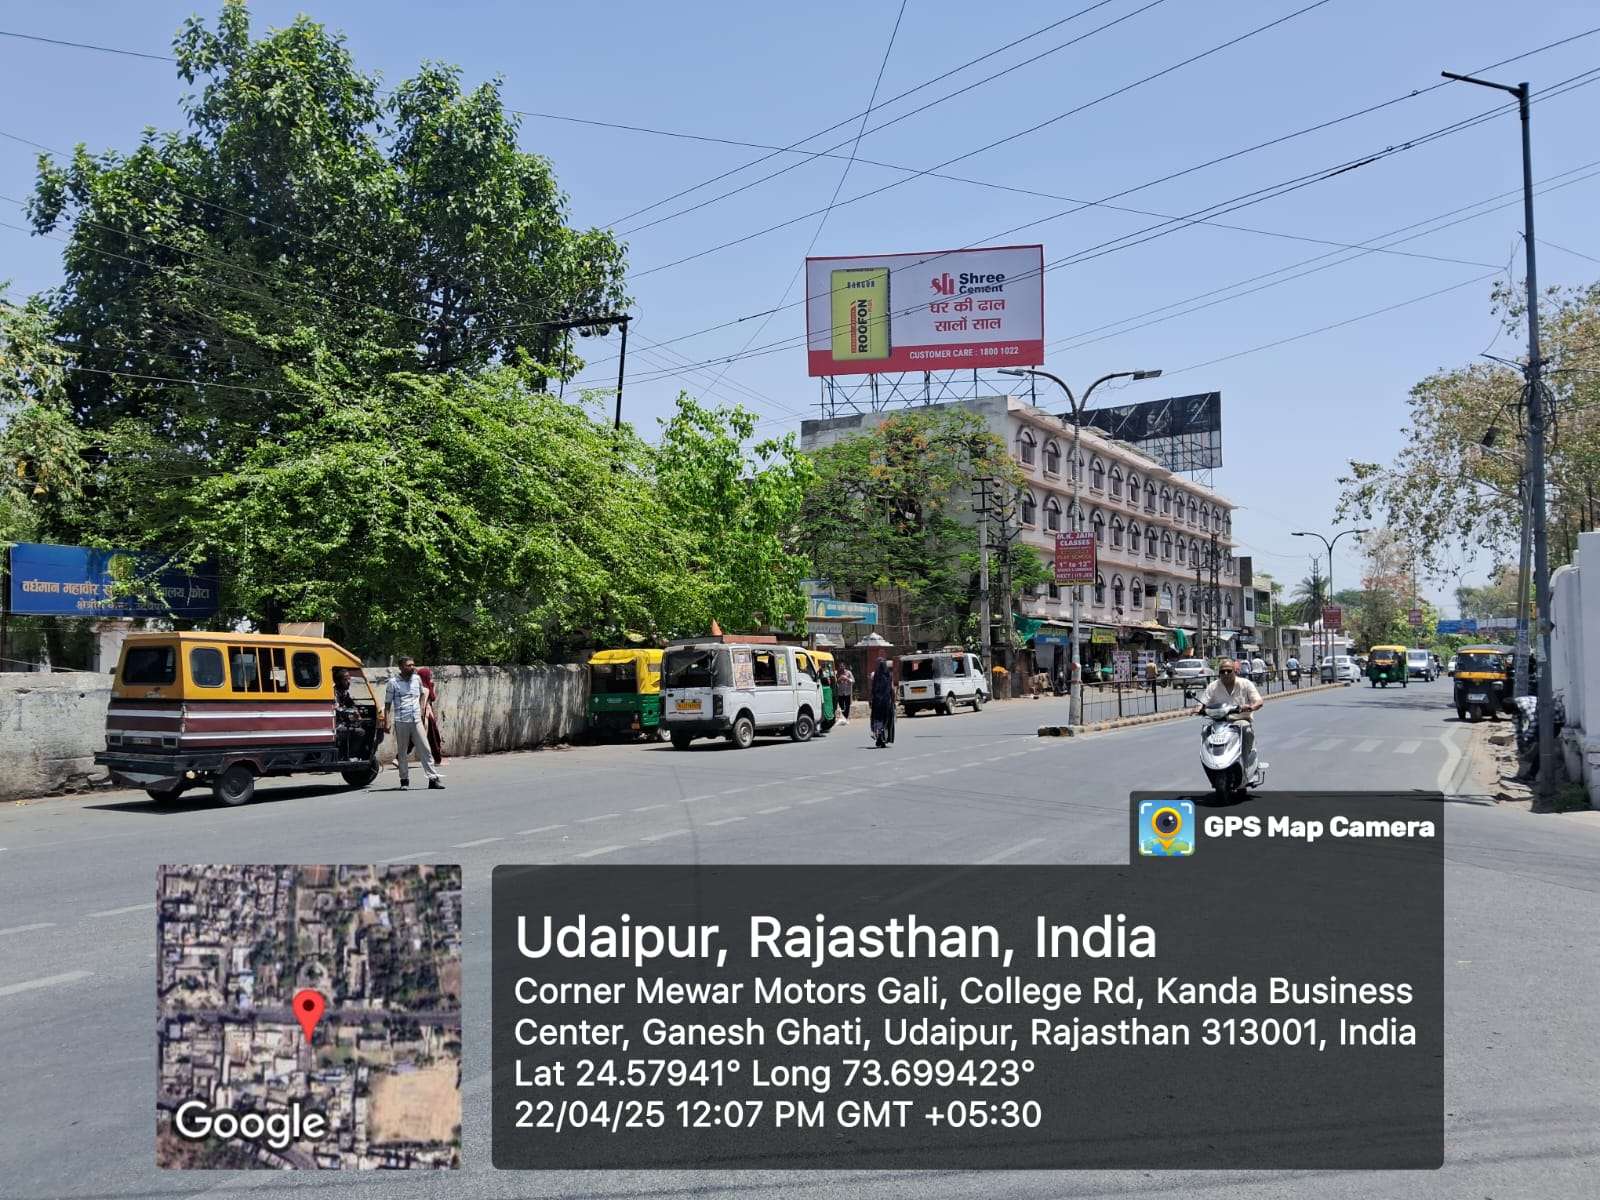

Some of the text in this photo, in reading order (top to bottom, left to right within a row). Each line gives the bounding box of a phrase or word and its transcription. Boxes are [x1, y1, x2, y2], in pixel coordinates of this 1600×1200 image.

[959, 272, 1005, 285] Shree
[959, 284, 1004, 294] Cement
[929, 297, 1005, 314] घर की ढाल
[857, 299, 868, 353] ROOFON
[934, 315, 1001, 332] सालों साल
[909, 350, 951, 360] CUSTOMER
[952, 348, 974, 357] CARE
[980, 348, 998, 356] 1800
[1000, 346, 1019, 355] 1022
[63, 581, 98, 595] महावीर
